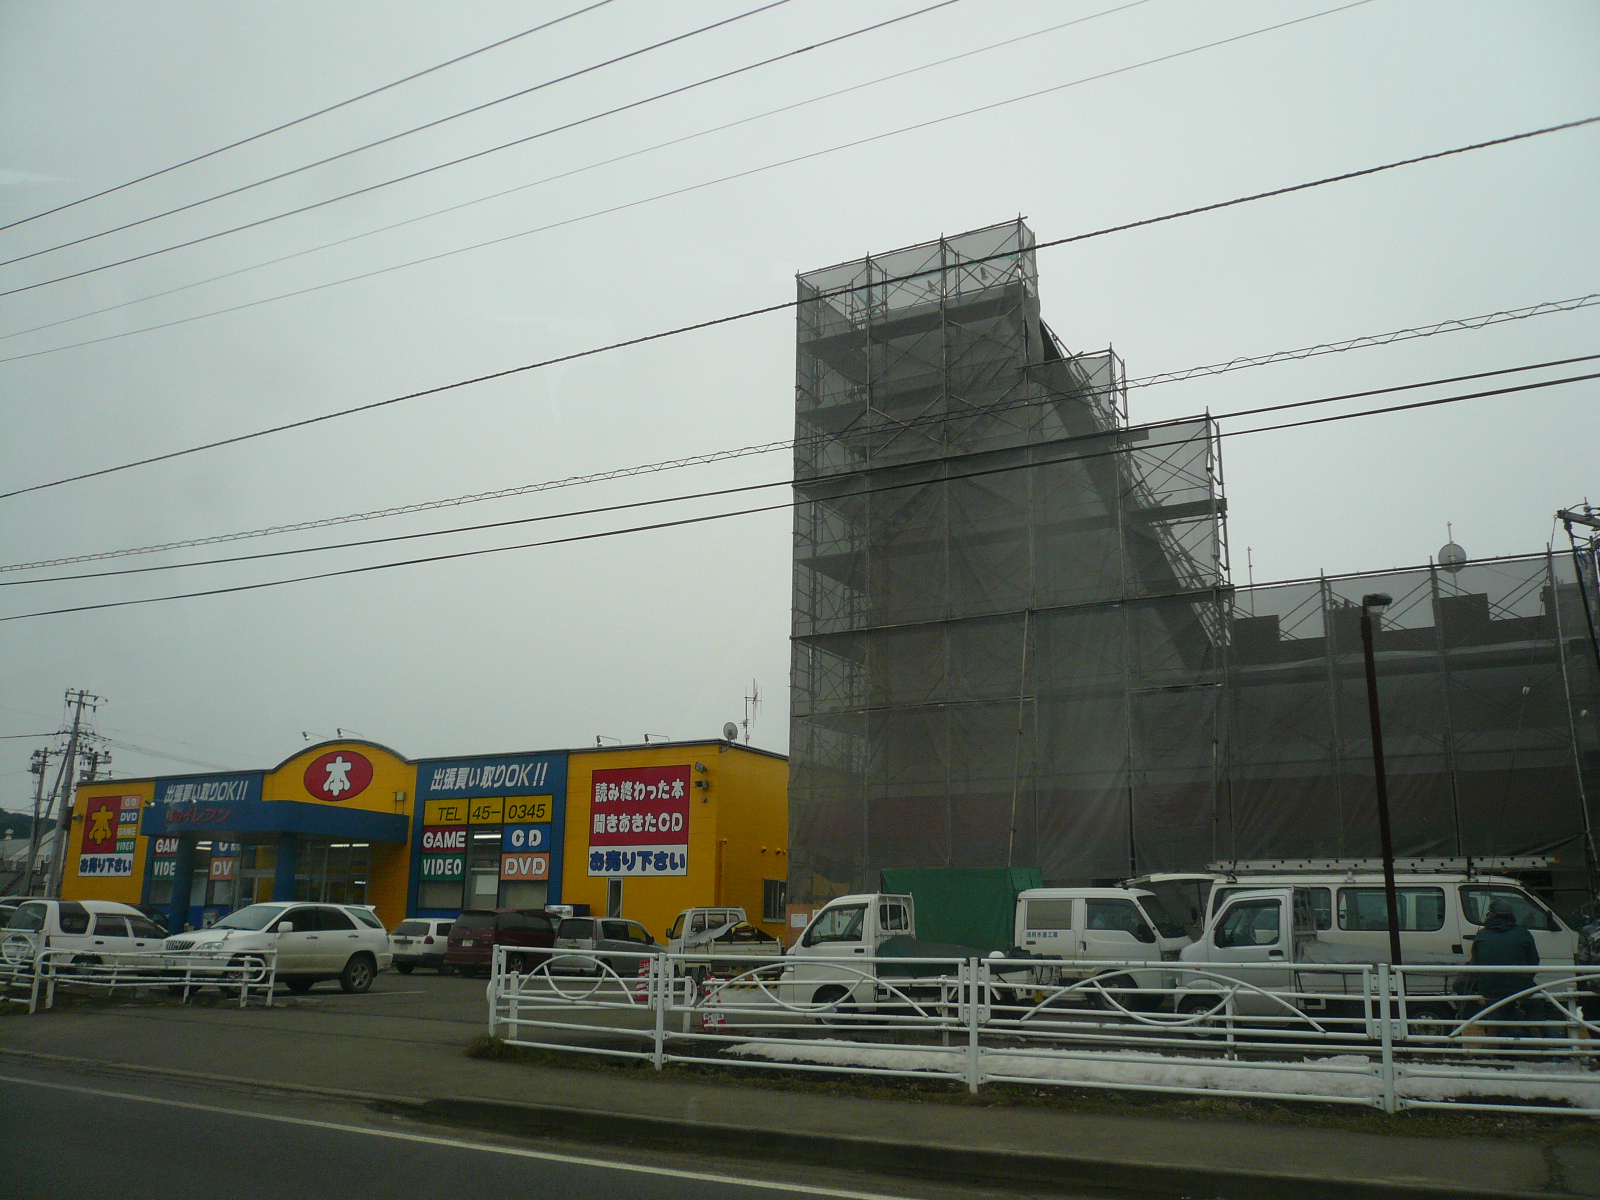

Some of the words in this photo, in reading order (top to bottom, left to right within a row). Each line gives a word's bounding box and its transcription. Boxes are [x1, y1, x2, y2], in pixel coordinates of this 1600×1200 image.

[594, 777, 685, 803] 読み終わった本
[120, 812, 137, 822] DVD
[438, 806, 462, 821] TEL
[508, 803, 546, 819] 0345
[117, 826, 137, 836] GAME
[593, 812, 683, 834] 聞きあきたCD
[116, 841, 135, 851] VIDEO
[155, 838, 179, 853] GAM
[422, 831, 467, 849] GAME
[511, 829, 542, 847] CD
[79, 856, 132, 874] お売り下さい
[154, 861, 176, 876] VIDE
[212, 860, 233, 876] DV
[423, 858, 462, 876] VIDEO
[504, 856, 546, 876] DVD
[589, 849, 686, 872] お売り下さい
